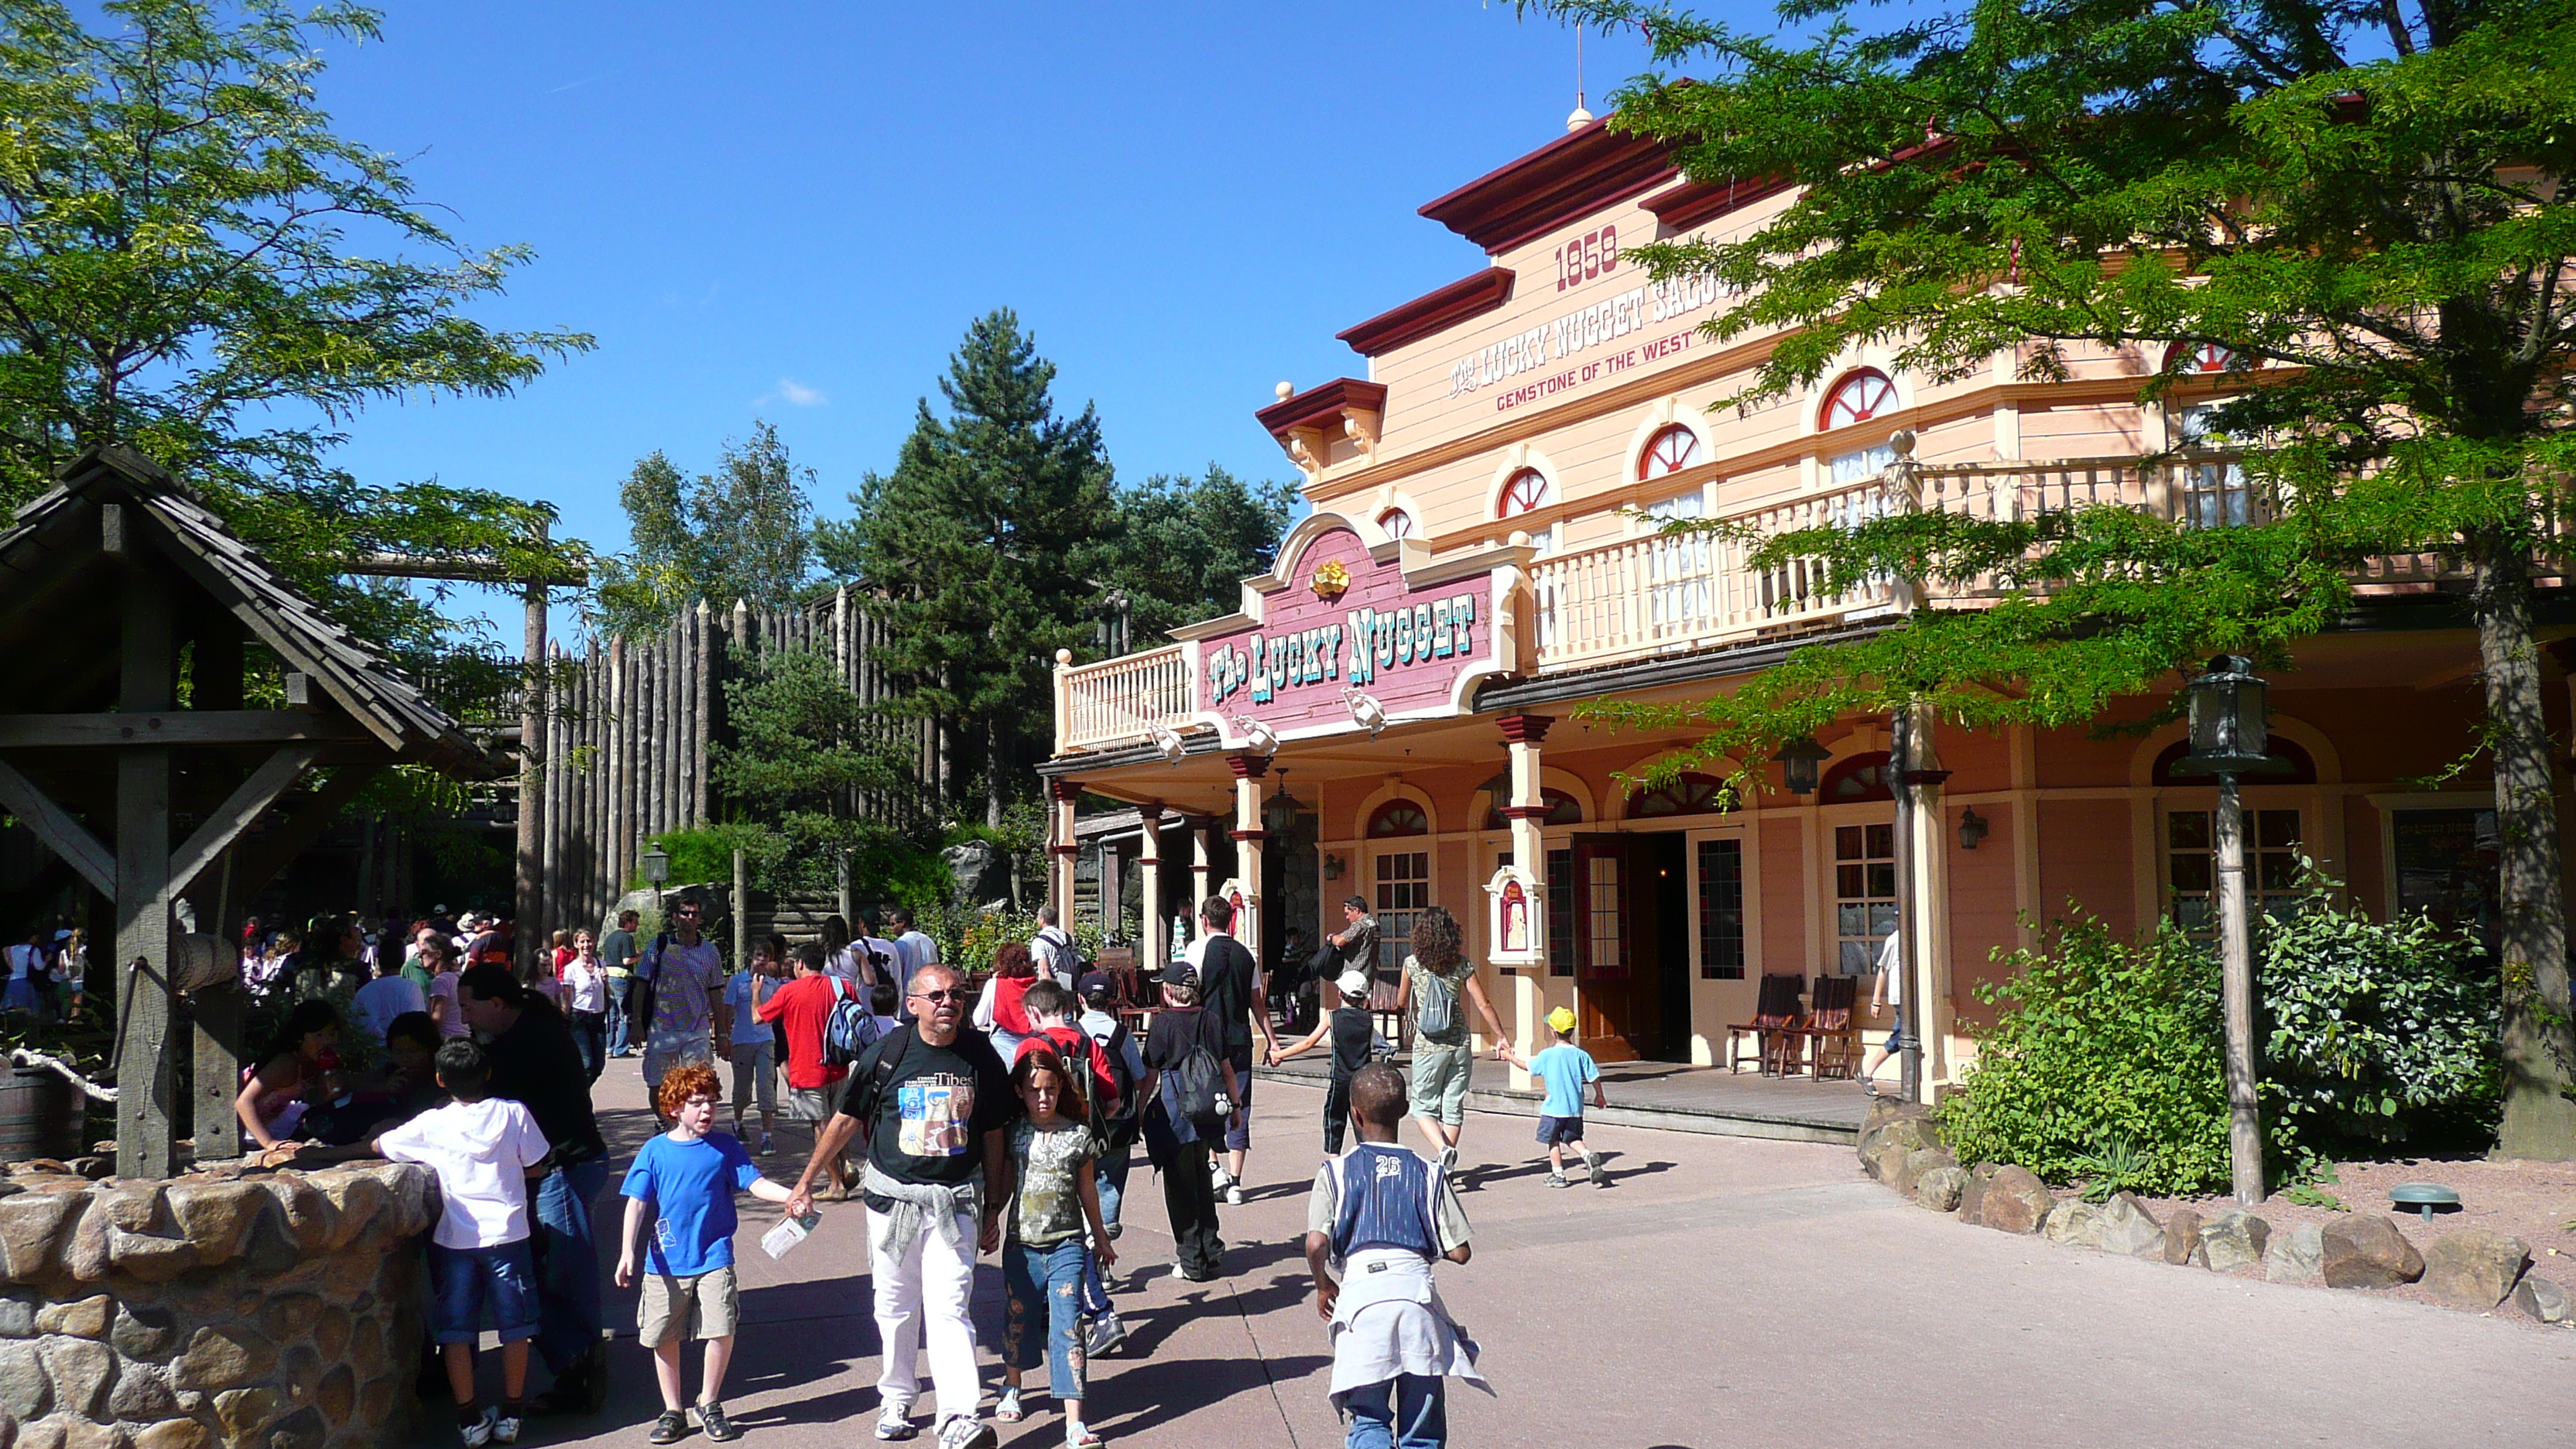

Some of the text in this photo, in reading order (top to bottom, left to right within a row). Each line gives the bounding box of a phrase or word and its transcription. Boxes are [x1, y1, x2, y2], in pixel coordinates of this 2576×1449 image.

[1555, 224, 1618, 293] 1858
[1480, 324, 1550, 387] LUCKY
[1553, 287, 1646, 360] NUGGET
[1497, 331, 1693, 412] GEMSTONE OF THE WEST
[1210, 593, 1474, 704] The LUCKY NUGGET
[933, 1072, 974, 1086] Tibes
[1375, 1155, 1400, 1174] 26
